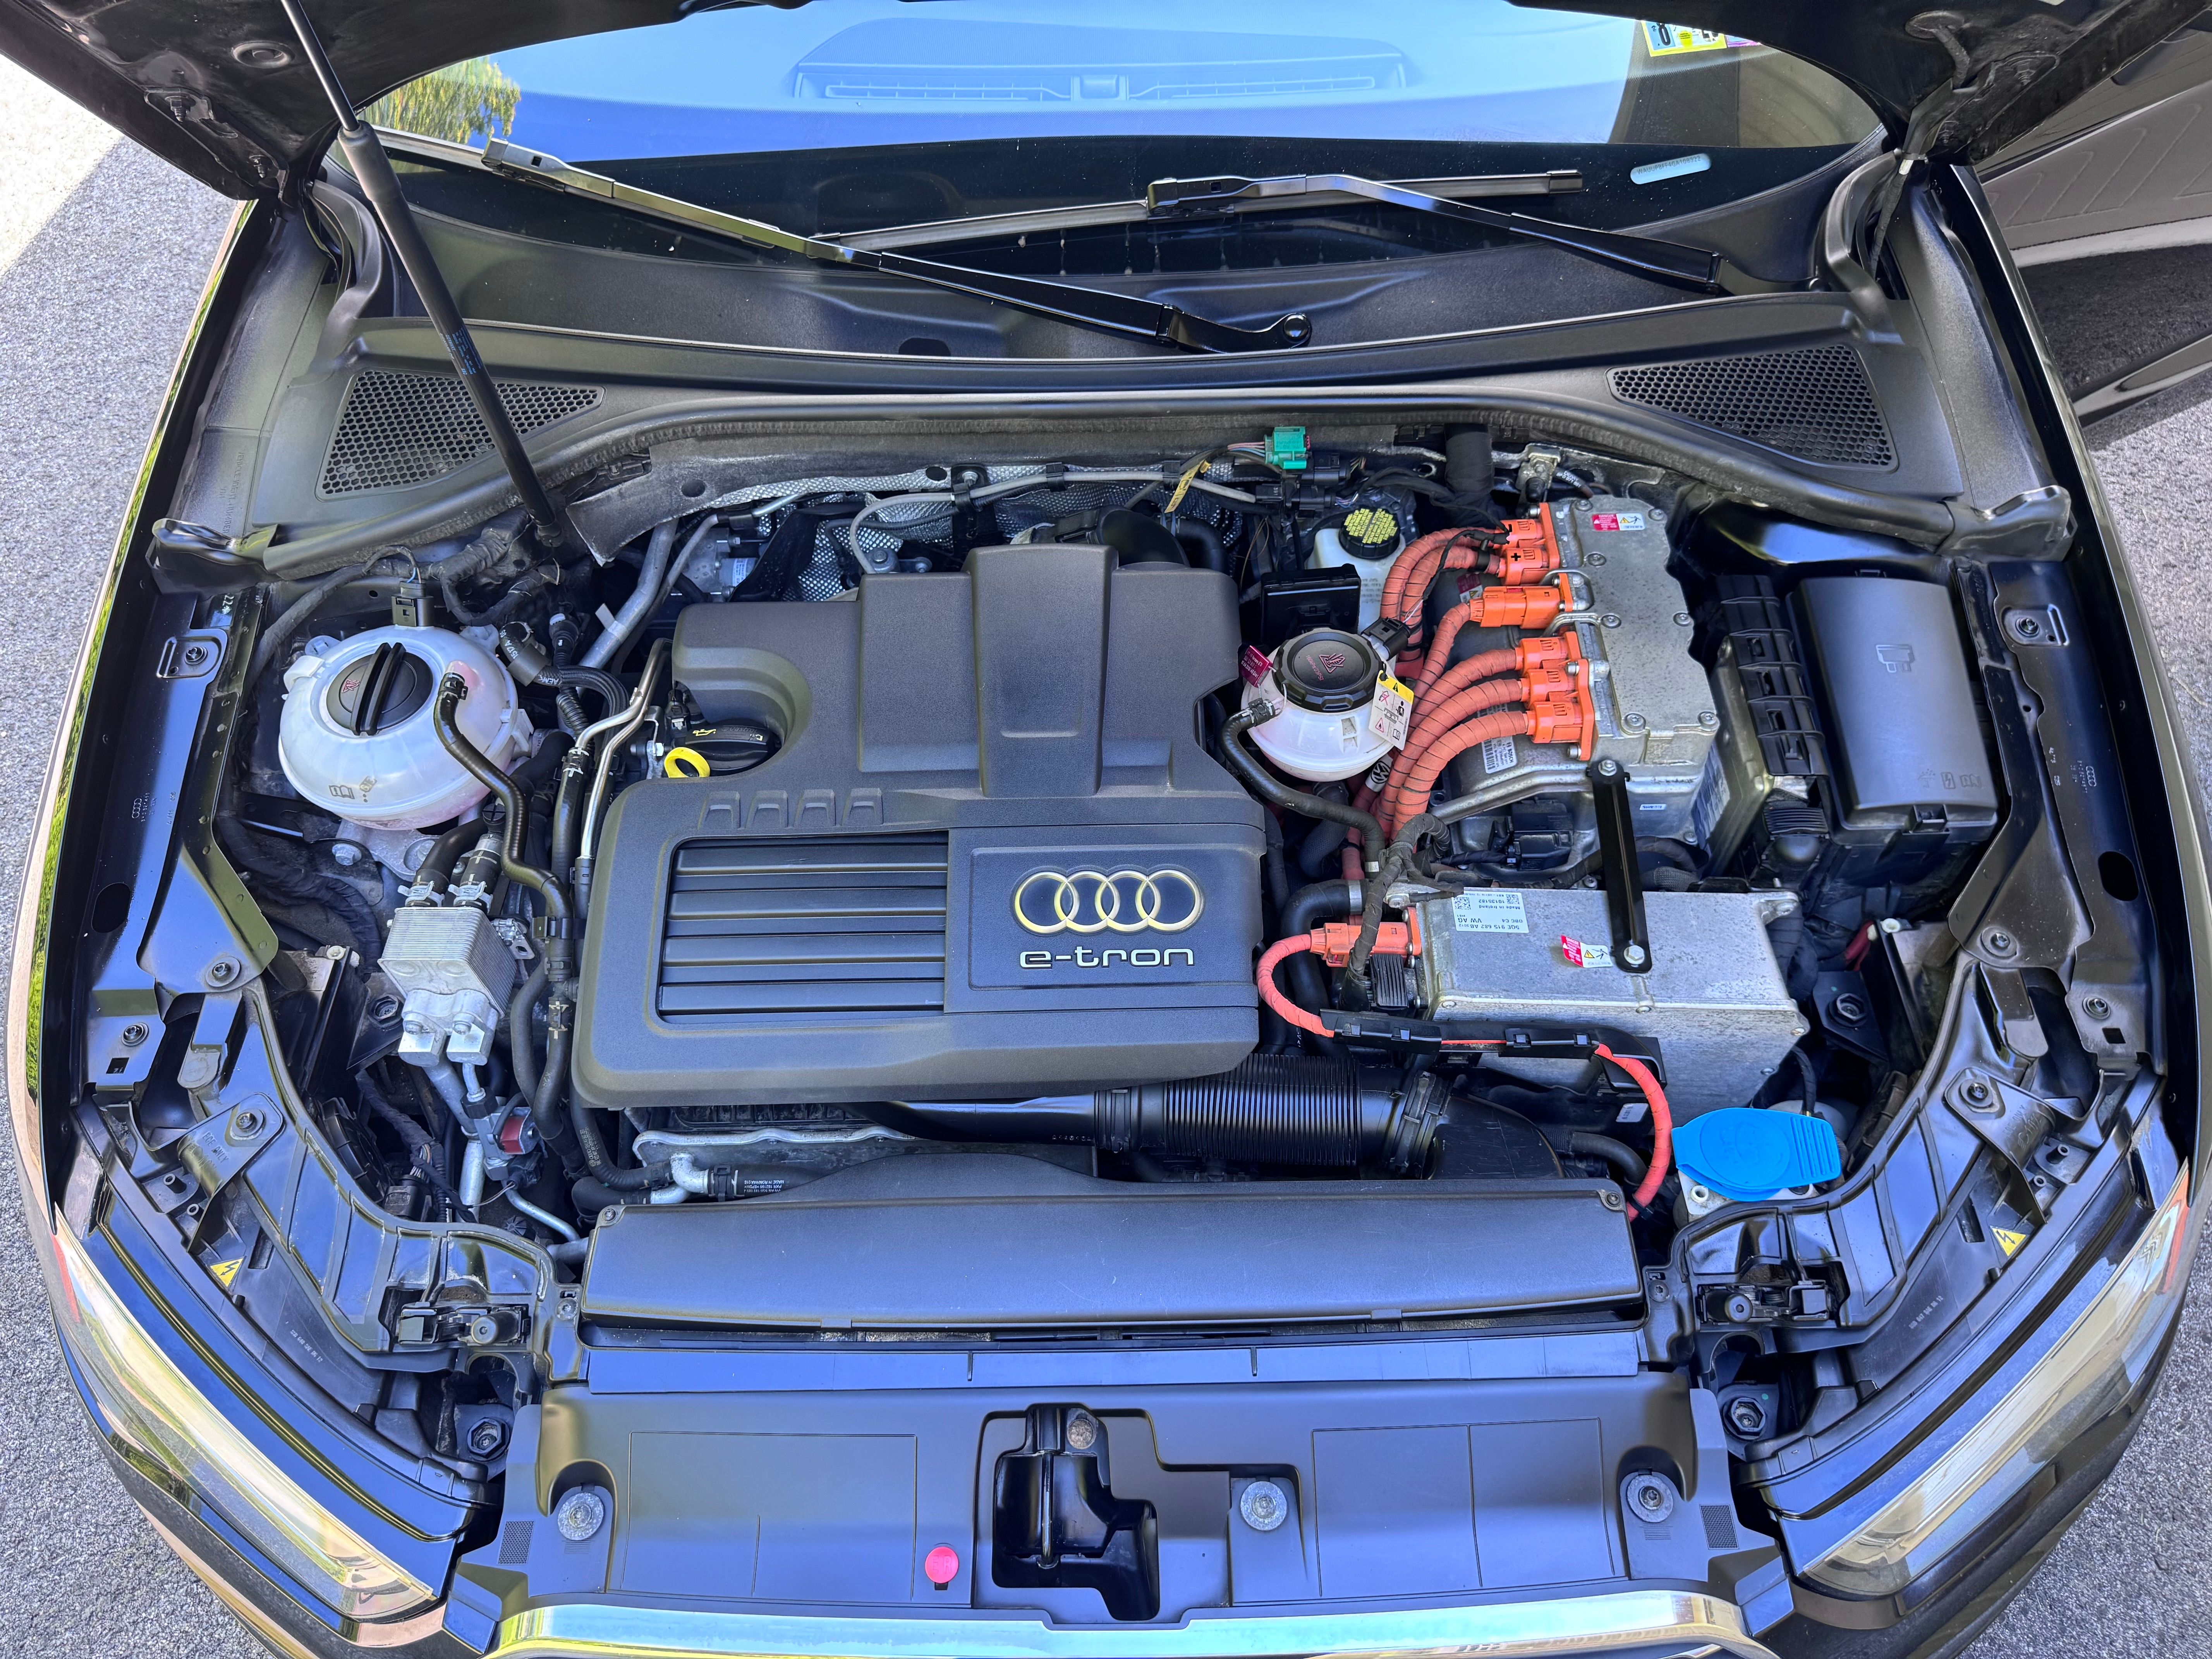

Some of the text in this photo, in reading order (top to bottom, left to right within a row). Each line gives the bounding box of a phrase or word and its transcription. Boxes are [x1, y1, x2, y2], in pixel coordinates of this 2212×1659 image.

[1637, 155, 1701, 174] WAUUPBFF4GA108322
[1019, 946, 1195, 969] e-tron
[202, 1131, 216, 1146] ECE
[933, 1555, 952, 1574] ER
